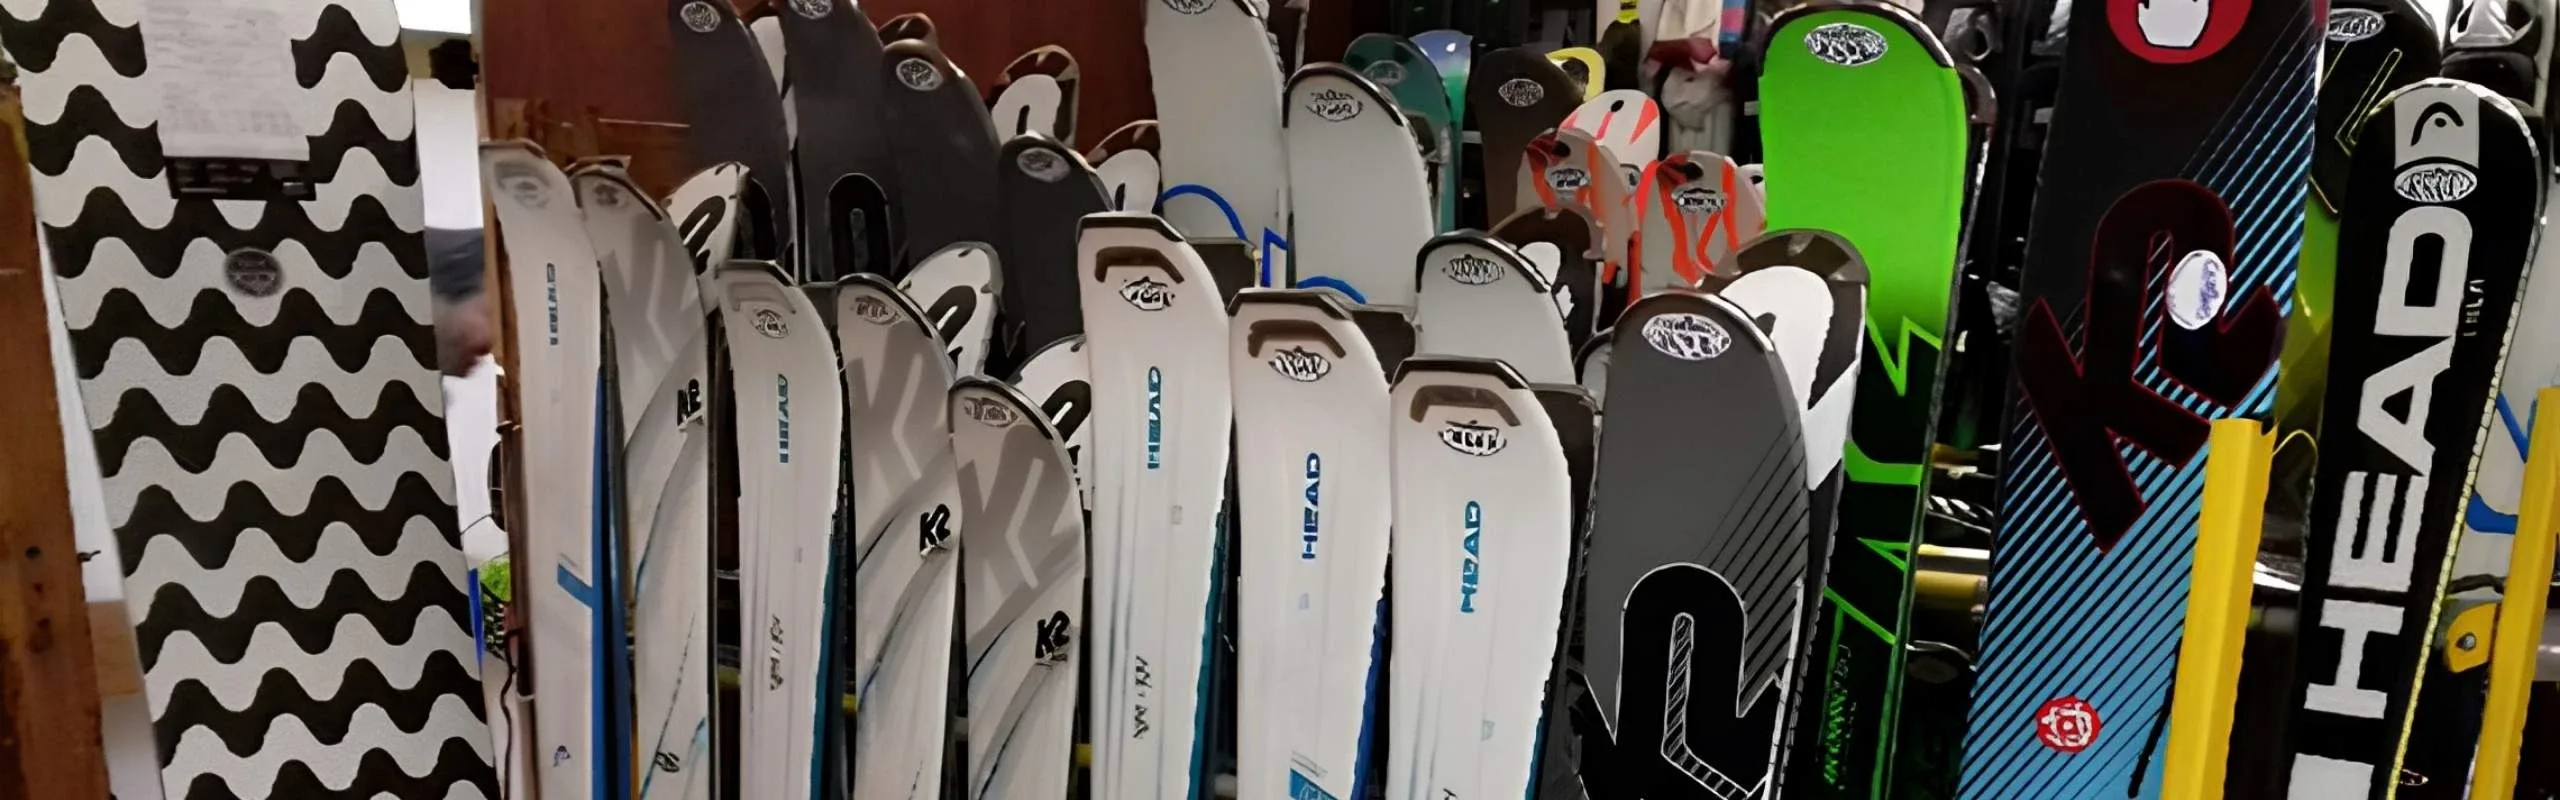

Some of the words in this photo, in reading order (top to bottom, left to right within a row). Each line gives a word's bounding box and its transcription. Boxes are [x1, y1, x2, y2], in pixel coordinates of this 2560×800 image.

[1147, 366, 1162, 469] HEAD
[2018, 179, 2283, 555] K2
[1302, 452, 1320, 559] HEAD
[2303, 205, 2474, 719] HEAD
[919, 503, 951, 555] K2
[1460, 501, 1482, 613] HEAD
[1035, 610, 1071, 661] K2
